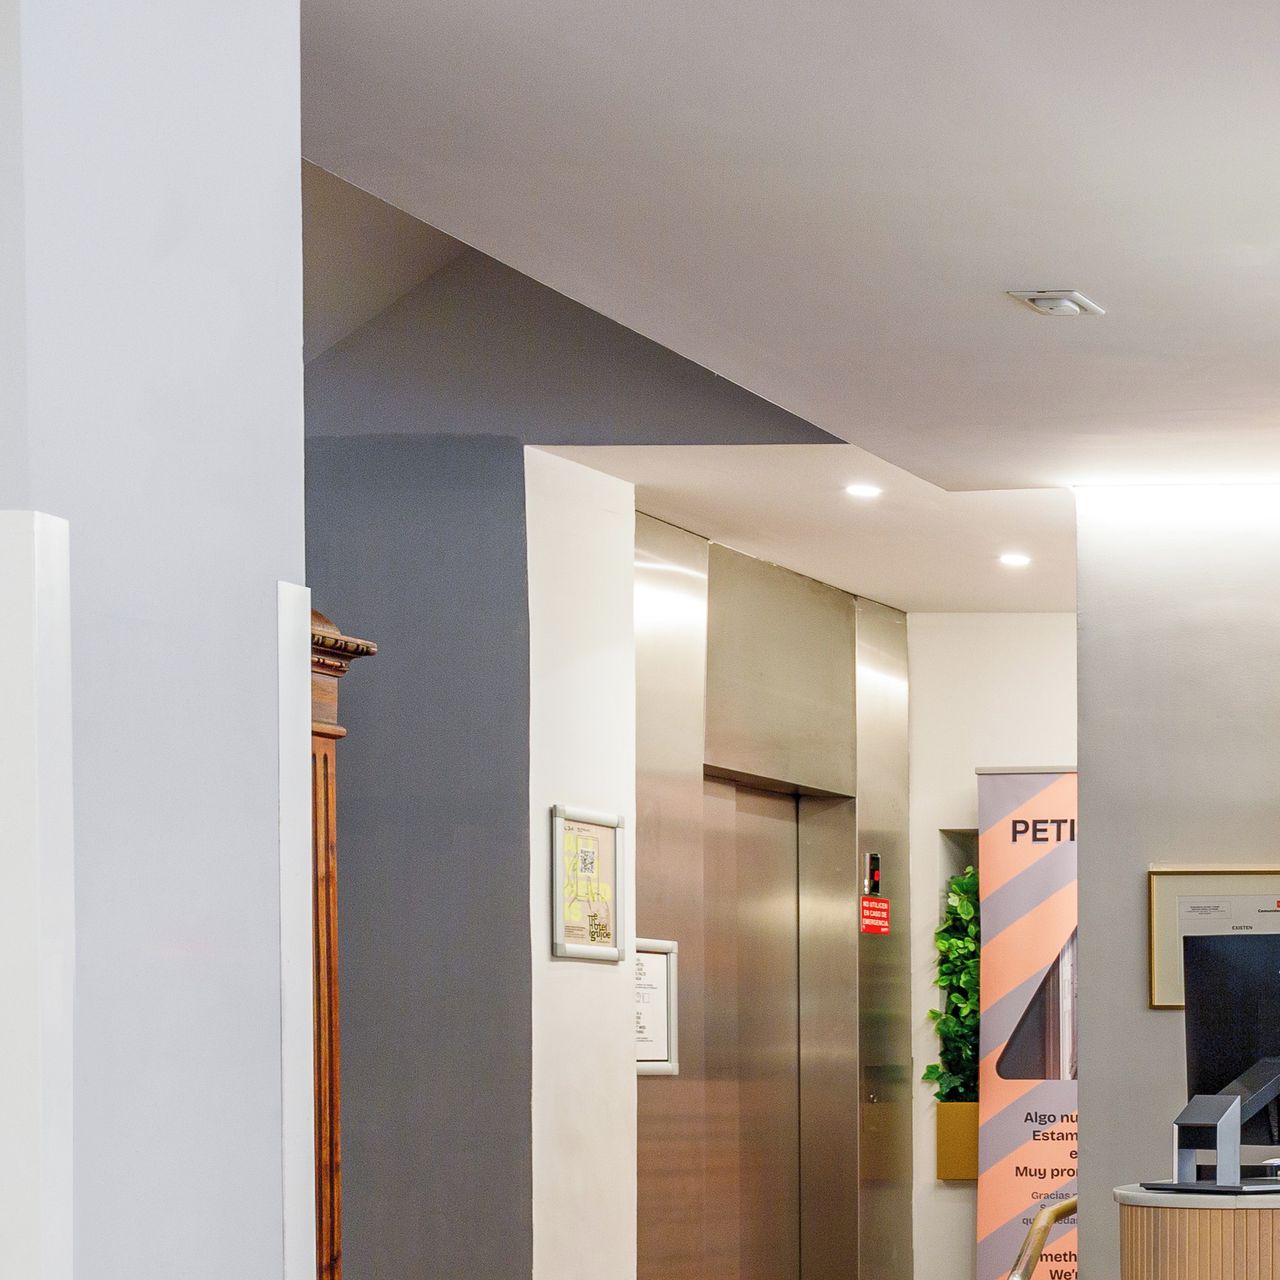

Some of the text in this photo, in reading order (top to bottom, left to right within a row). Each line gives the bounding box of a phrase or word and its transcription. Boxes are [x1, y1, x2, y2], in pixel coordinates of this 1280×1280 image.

[1011, 819, 1075, 842] PETI
[1024, 1111, 1056, 1125] Algo
[1032, 1130, 1078, 1141] Estam
[1015, 1166, 1046, 1179] Muy
[1031, 1191, 1070, 1200] Gracias
[1039, 1251, 1077, 1262] meth
